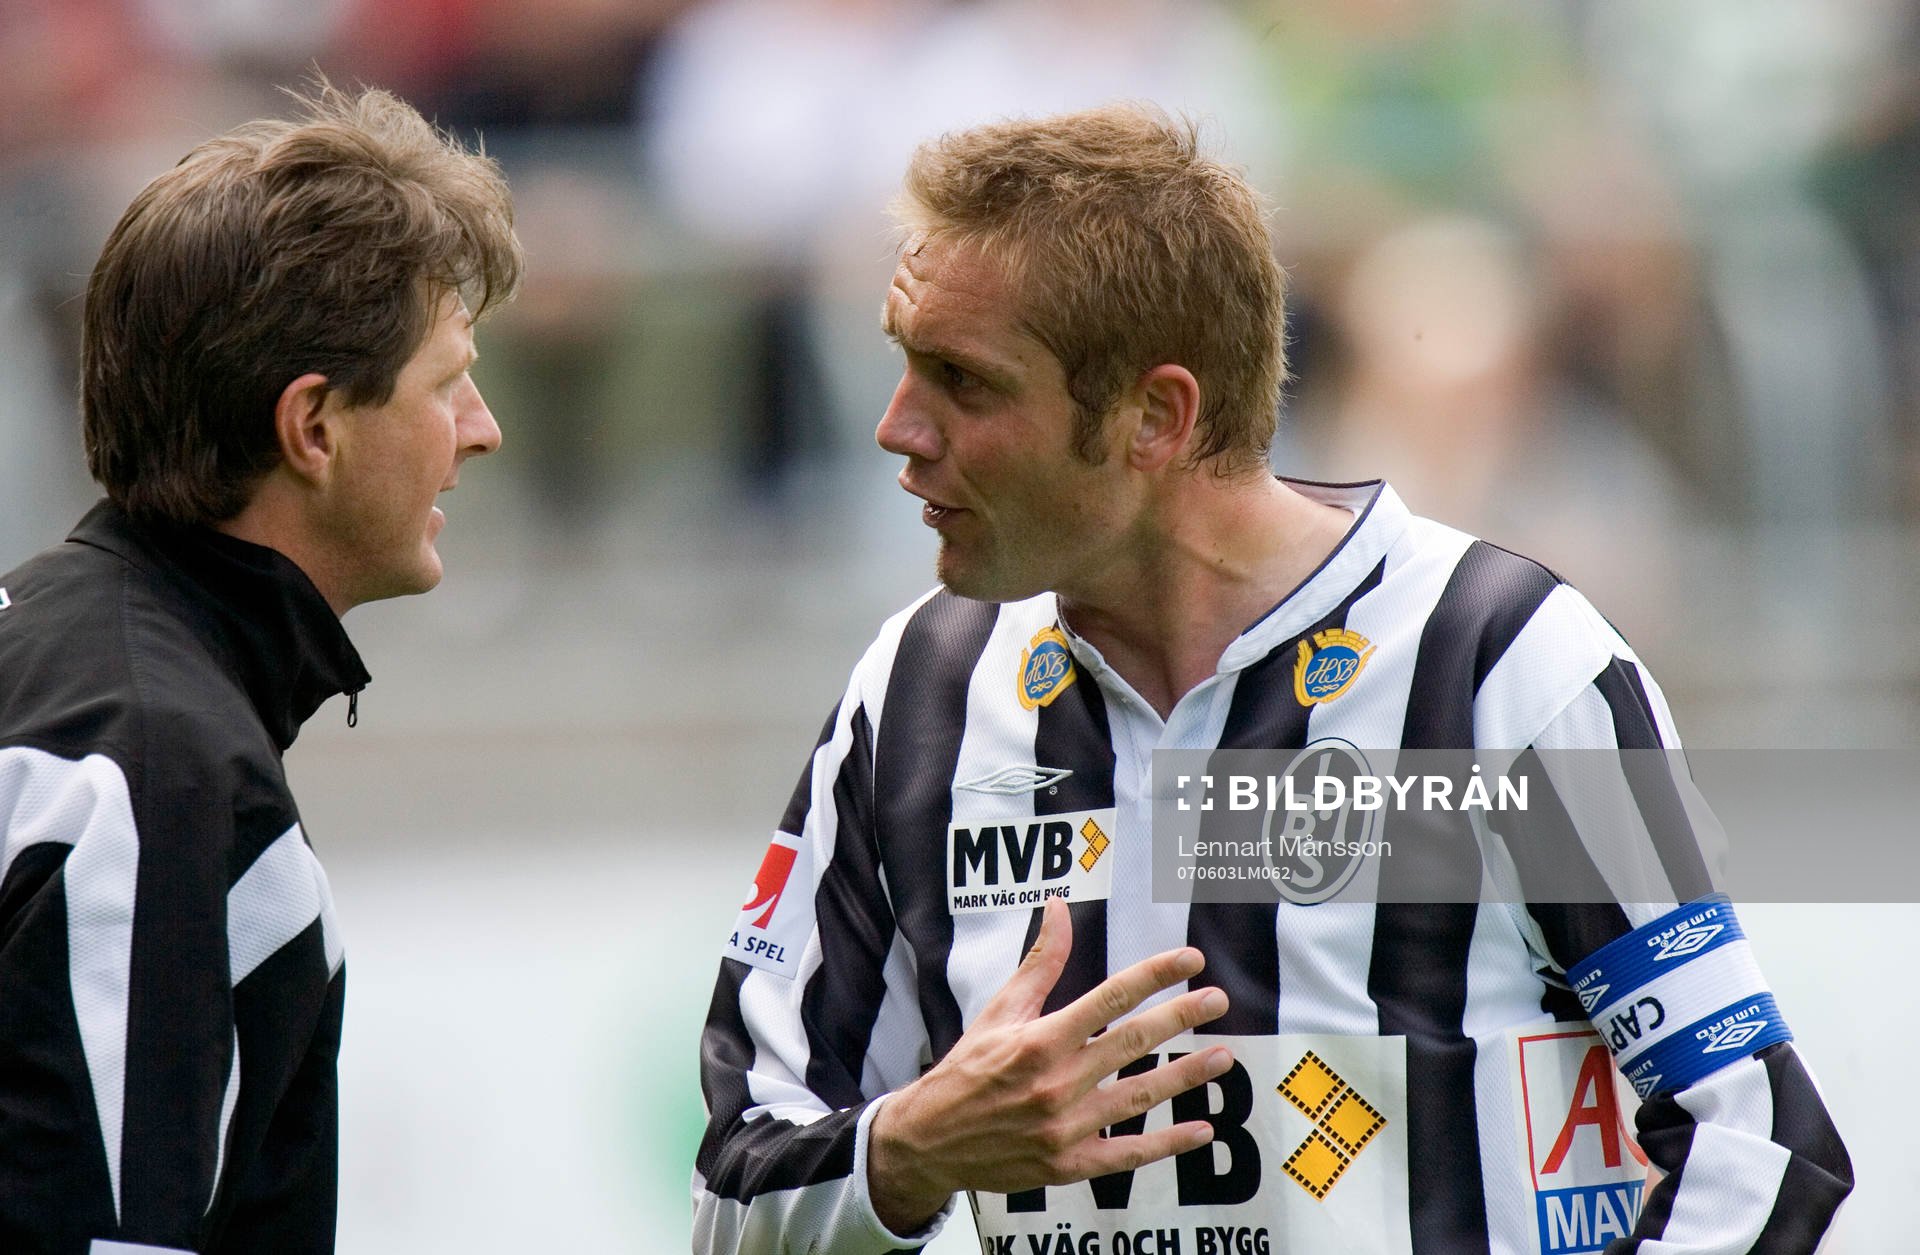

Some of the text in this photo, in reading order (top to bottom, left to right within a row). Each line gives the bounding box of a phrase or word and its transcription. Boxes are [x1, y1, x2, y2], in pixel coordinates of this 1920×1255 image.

[953, 821, 1073, 888] MVB
[954, 895, 987, 909] MARK
[992, 889, 1015, 906] VÄG
[1019, 889, 1041, 904] OCH
[744, 936, 785, 963] SPEL
[1027, 1222, 1100, 1255] VÄG
[1112, 1228, 1180, 1255] OCH
[1196, 1226, 1269, 1255] BYGG
